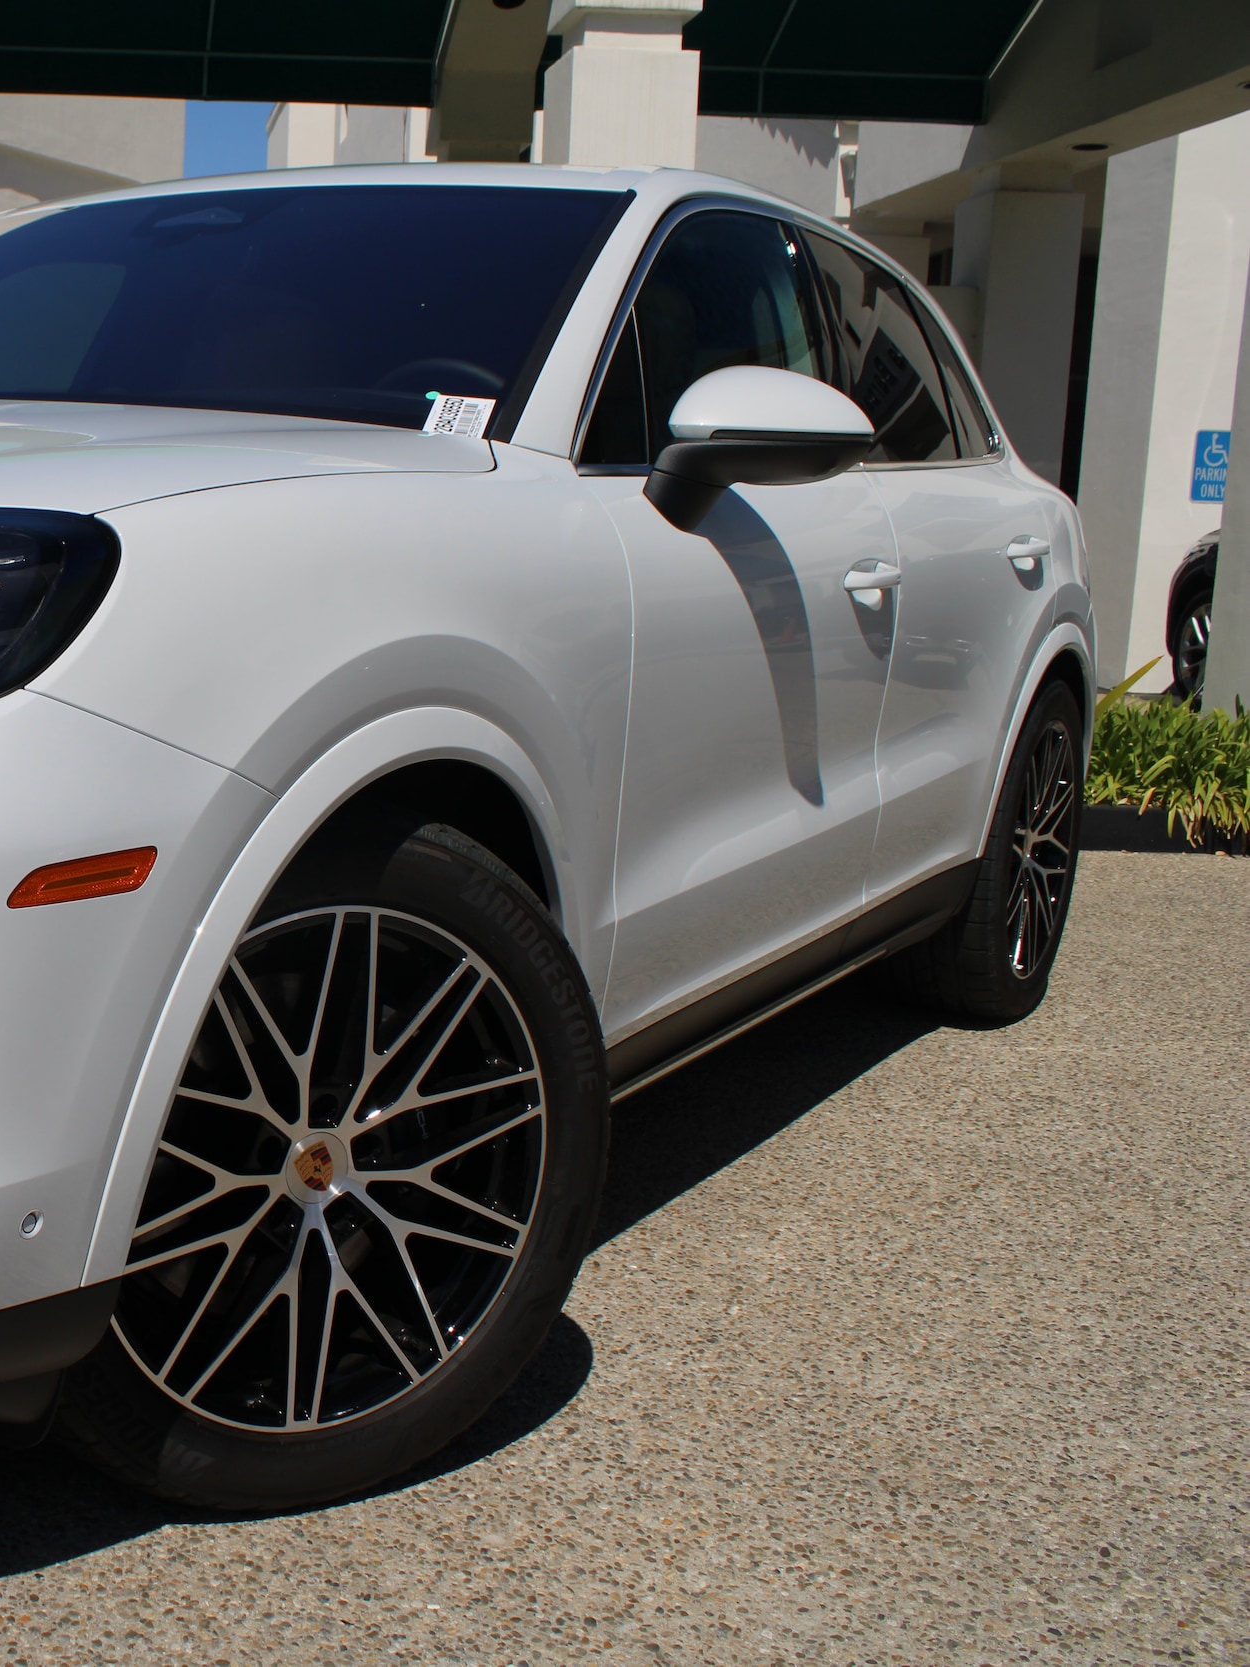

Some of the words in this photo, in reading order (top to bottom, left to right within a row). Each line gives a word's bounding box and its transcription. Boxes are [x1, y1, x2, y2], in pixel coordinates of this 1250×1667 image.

[1195, 467, 1227, 481] PARKI
[1201, 484, 1225, 498] ONLY
[460, 868, 598, 1093] BRIDGESTONE
